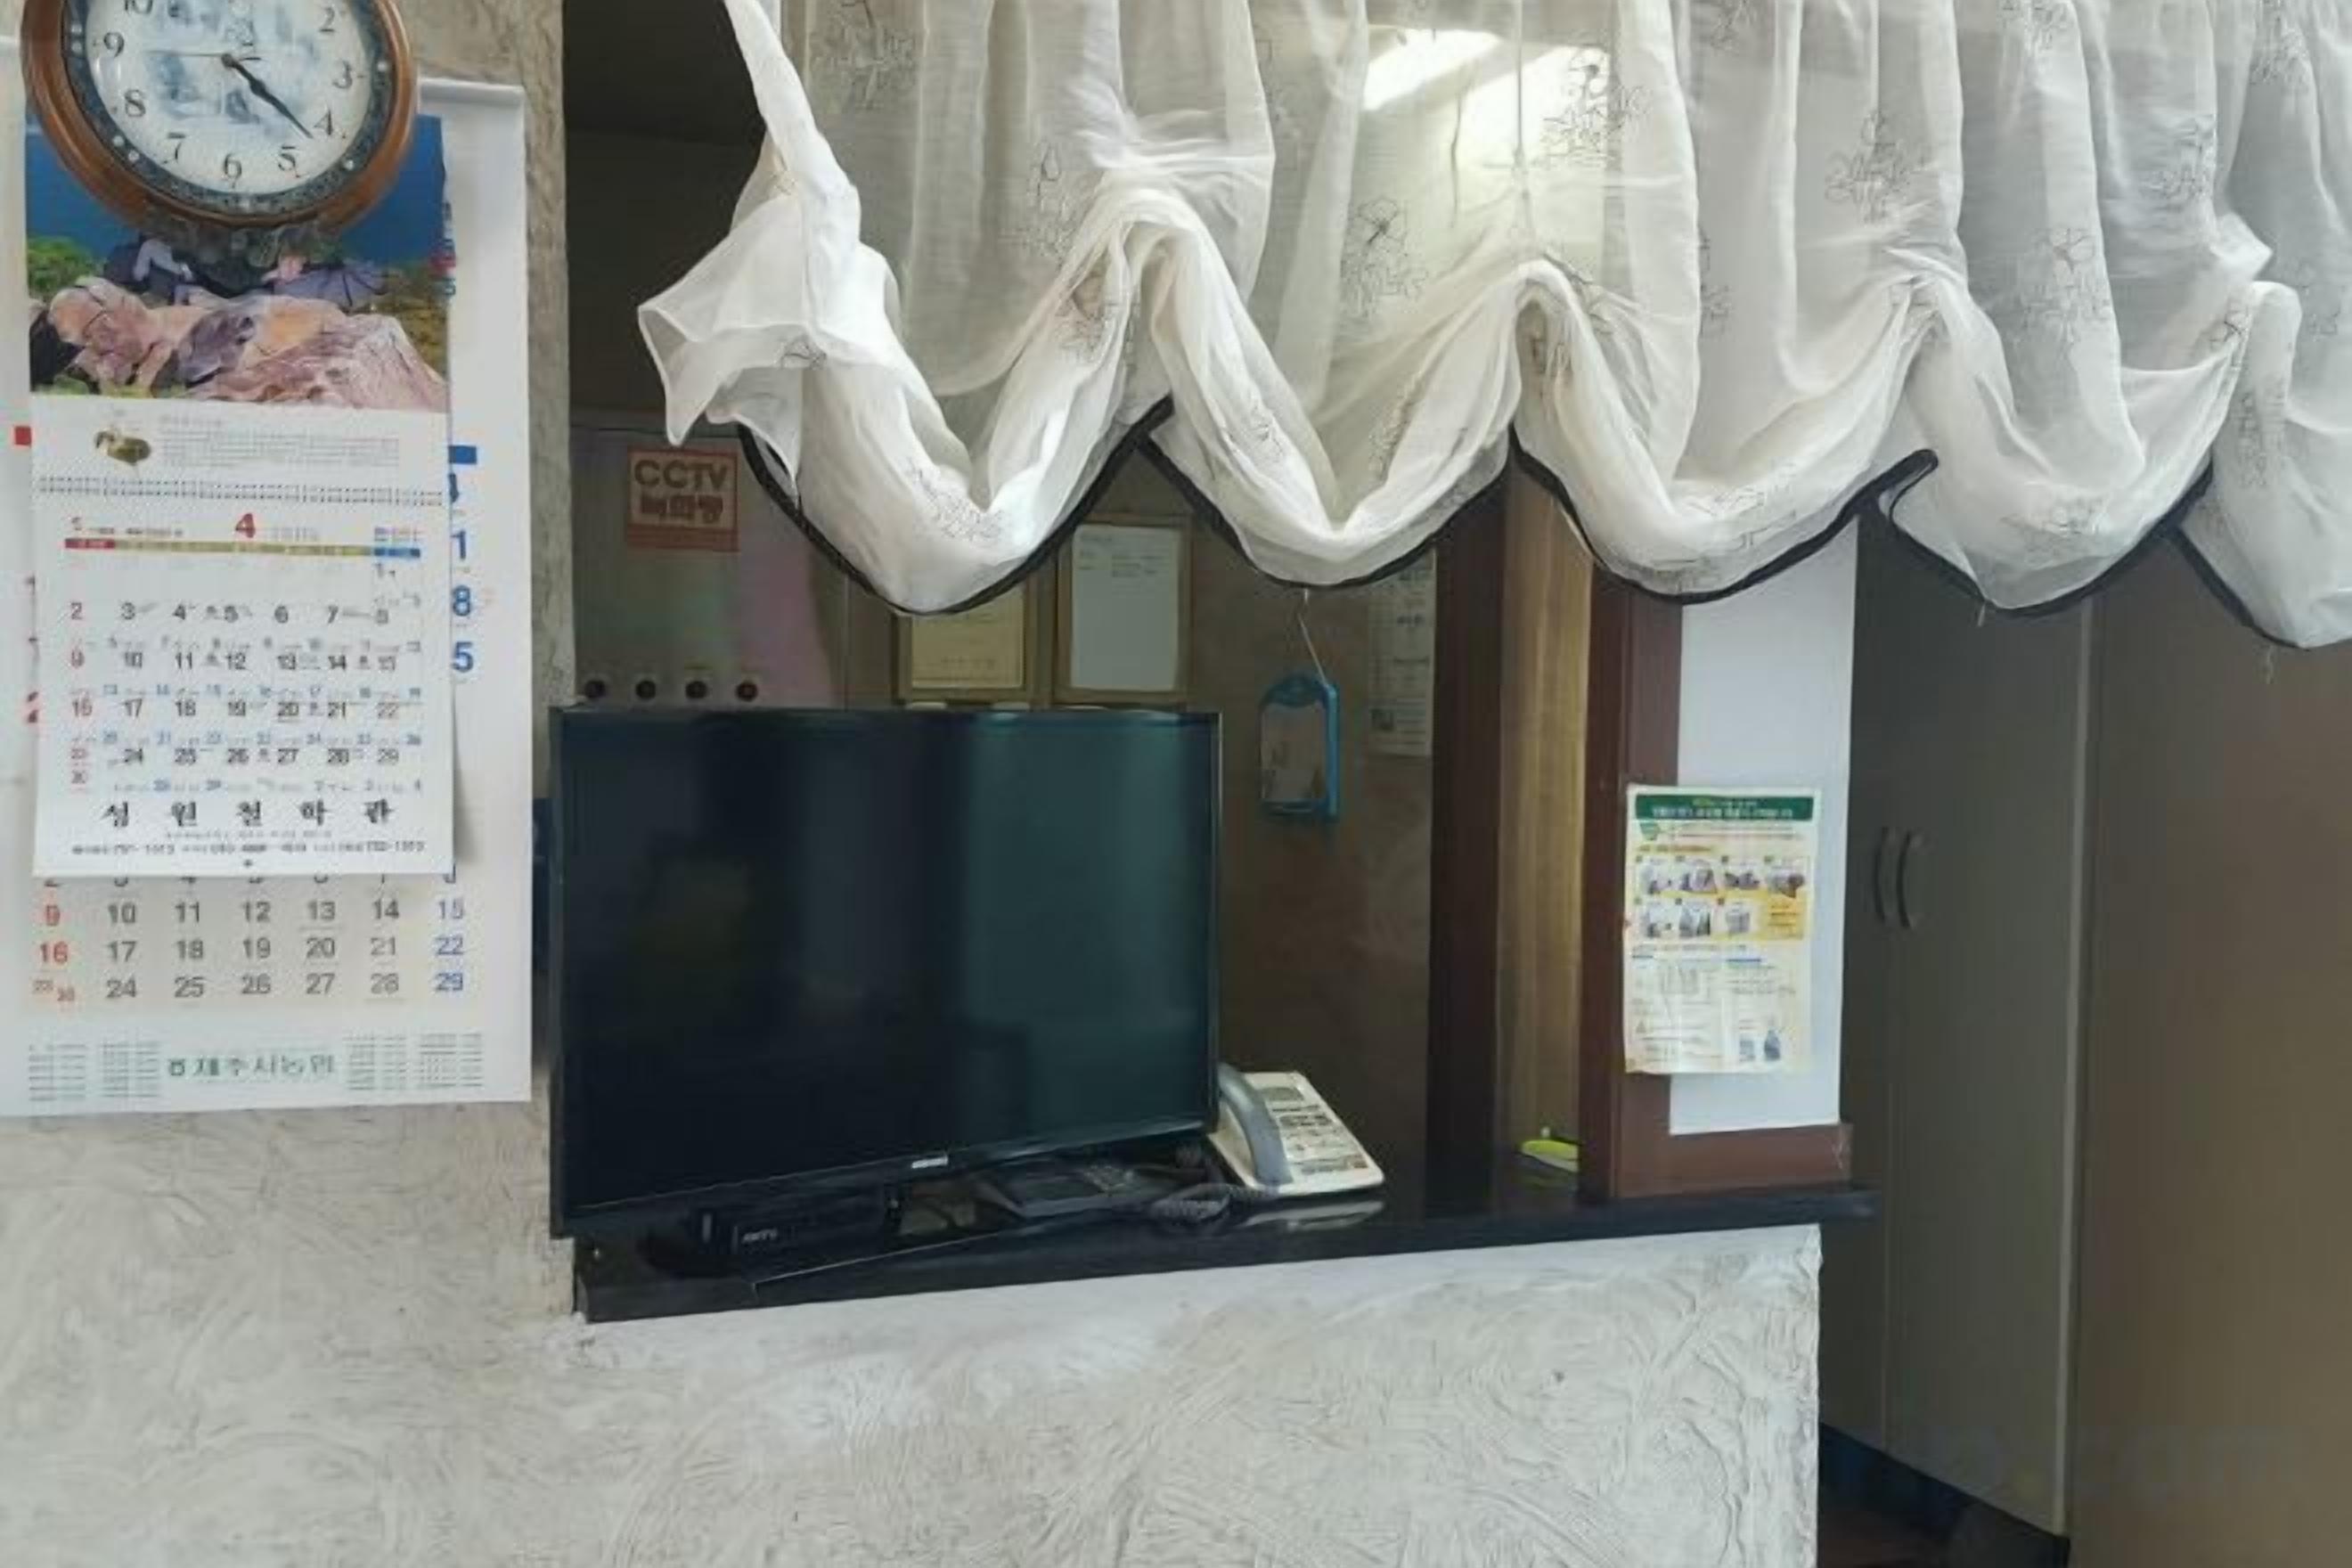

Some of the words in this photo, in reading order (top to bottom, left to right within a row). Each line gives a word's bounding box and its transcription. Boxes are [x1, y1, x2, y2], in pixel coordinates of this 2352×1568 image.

[318, 7, 336, 33] 2
[103, 31, 125, 57] 9
[332, 60, 353, 89] 3
[125, 89, 146, 118] 8
[314, 108, 334, 136] 4
[167, 133, 186, 161] 7
[277, 145, 298, 172] 5
[224, 152, 243, 181] 6
[633, 459, 728, 491] CCTV
[235, 512, 257, 539] 4
[70, 602, 82, 620] 2
[452, 585, 471, 617] 8
[176, 651, 192, 670] 11
[123, 698, 143, 716] 17
[108, 902, 135, 924] 10
[175, 902, 200, 924] 11
[242, 902, 271, 923] 12
[306, 901, 335, 921] 13
[372, 899, 399, 919] 14
[41, 941, 69, 964] 16
[109, 940, 136, 962] 17
[176, 939, 203, 960] 18
[242, 938, 271, 960] 19
[306, 936, 336, 959] 20
[371, 936, 396, 957] 21
[436, 936, 463, 956] 22
[106, 976, 136, 999] 24
[175, 976, 204, 998] 25
[241, 975, 271, 995] 26
[305, 973, 336, 995] 27
[371, 973, 399, 995] 28
[436, 972, 463, 992] 29
